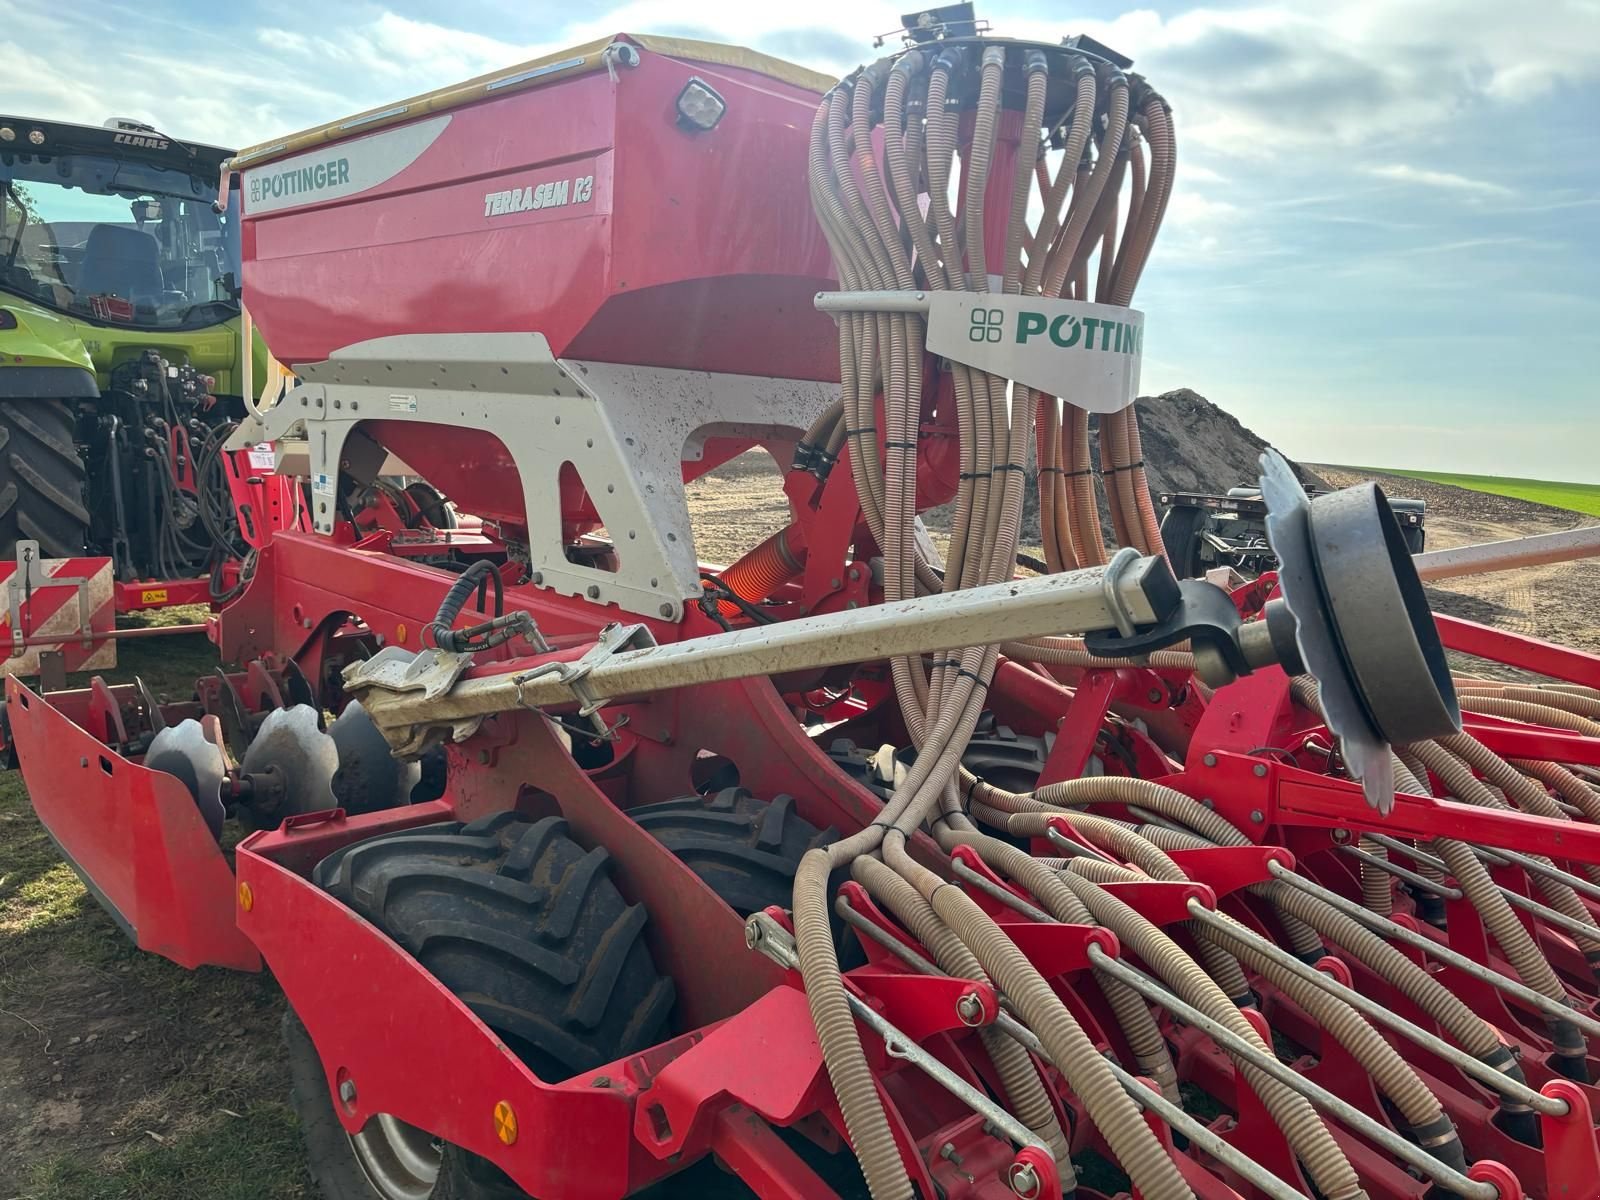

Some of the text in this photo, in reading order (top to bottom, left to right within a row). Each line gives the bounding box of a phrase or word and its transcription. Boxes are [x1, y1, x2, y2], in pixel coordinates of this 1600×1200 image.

[114, 133, 169, 150] CLAAS
[262, 158, 350, 200] PÖTTINGER
[484, 176, 593, 217] TERRASEM R3
